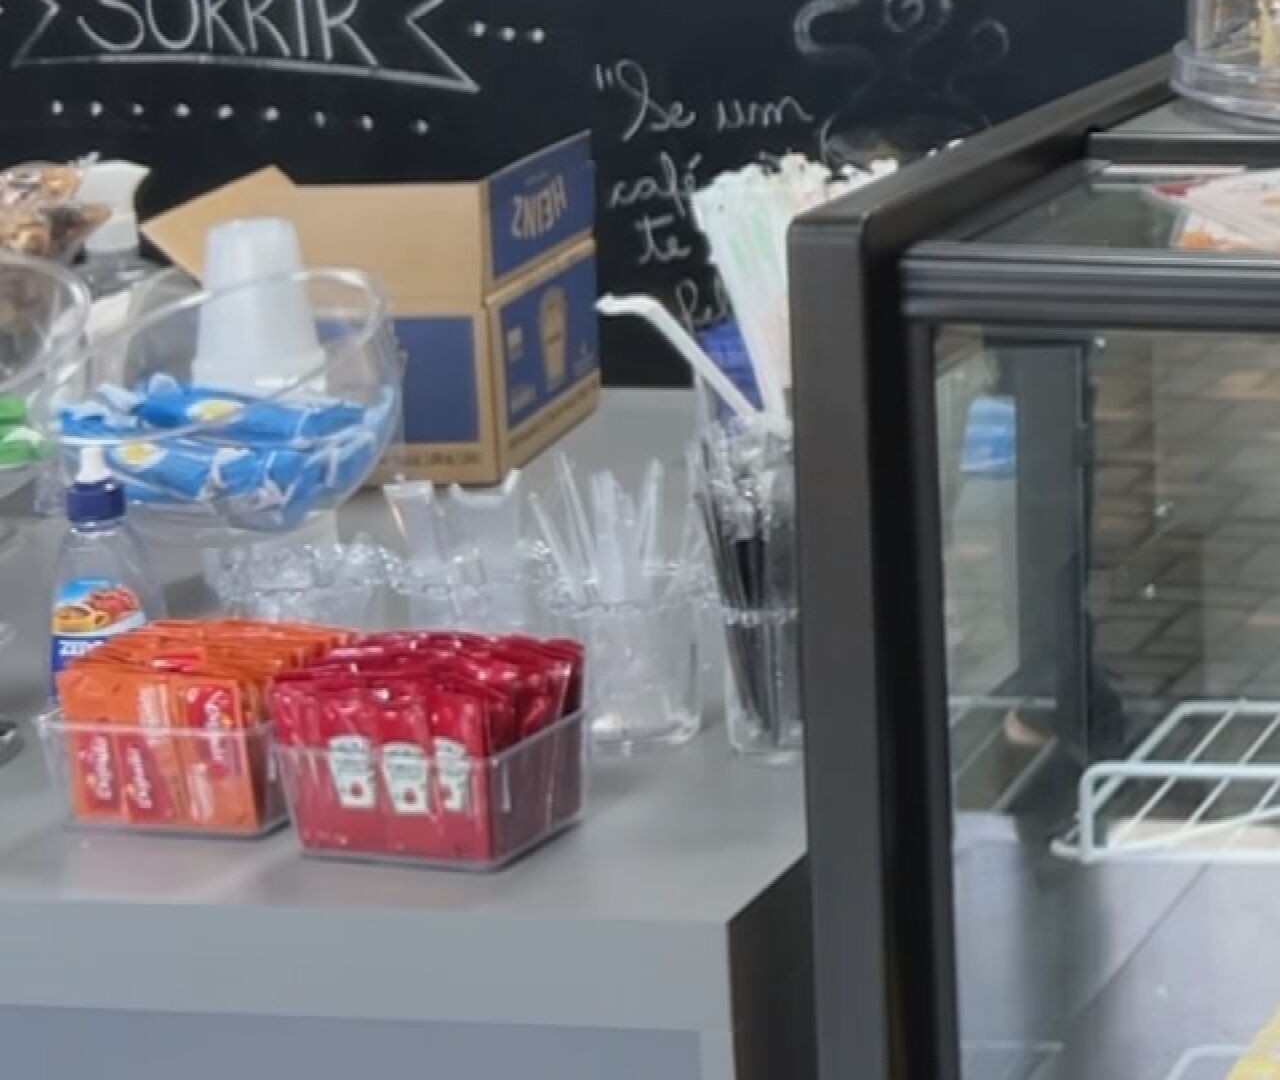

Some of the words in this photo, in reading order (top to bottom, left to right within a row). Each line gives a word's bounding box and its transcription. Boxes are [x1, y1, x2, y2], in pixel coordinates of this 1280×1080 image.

[716, 95, 815, 132] um
[607, 151, 703, 217] café
[634, 214, 692, 265] te
